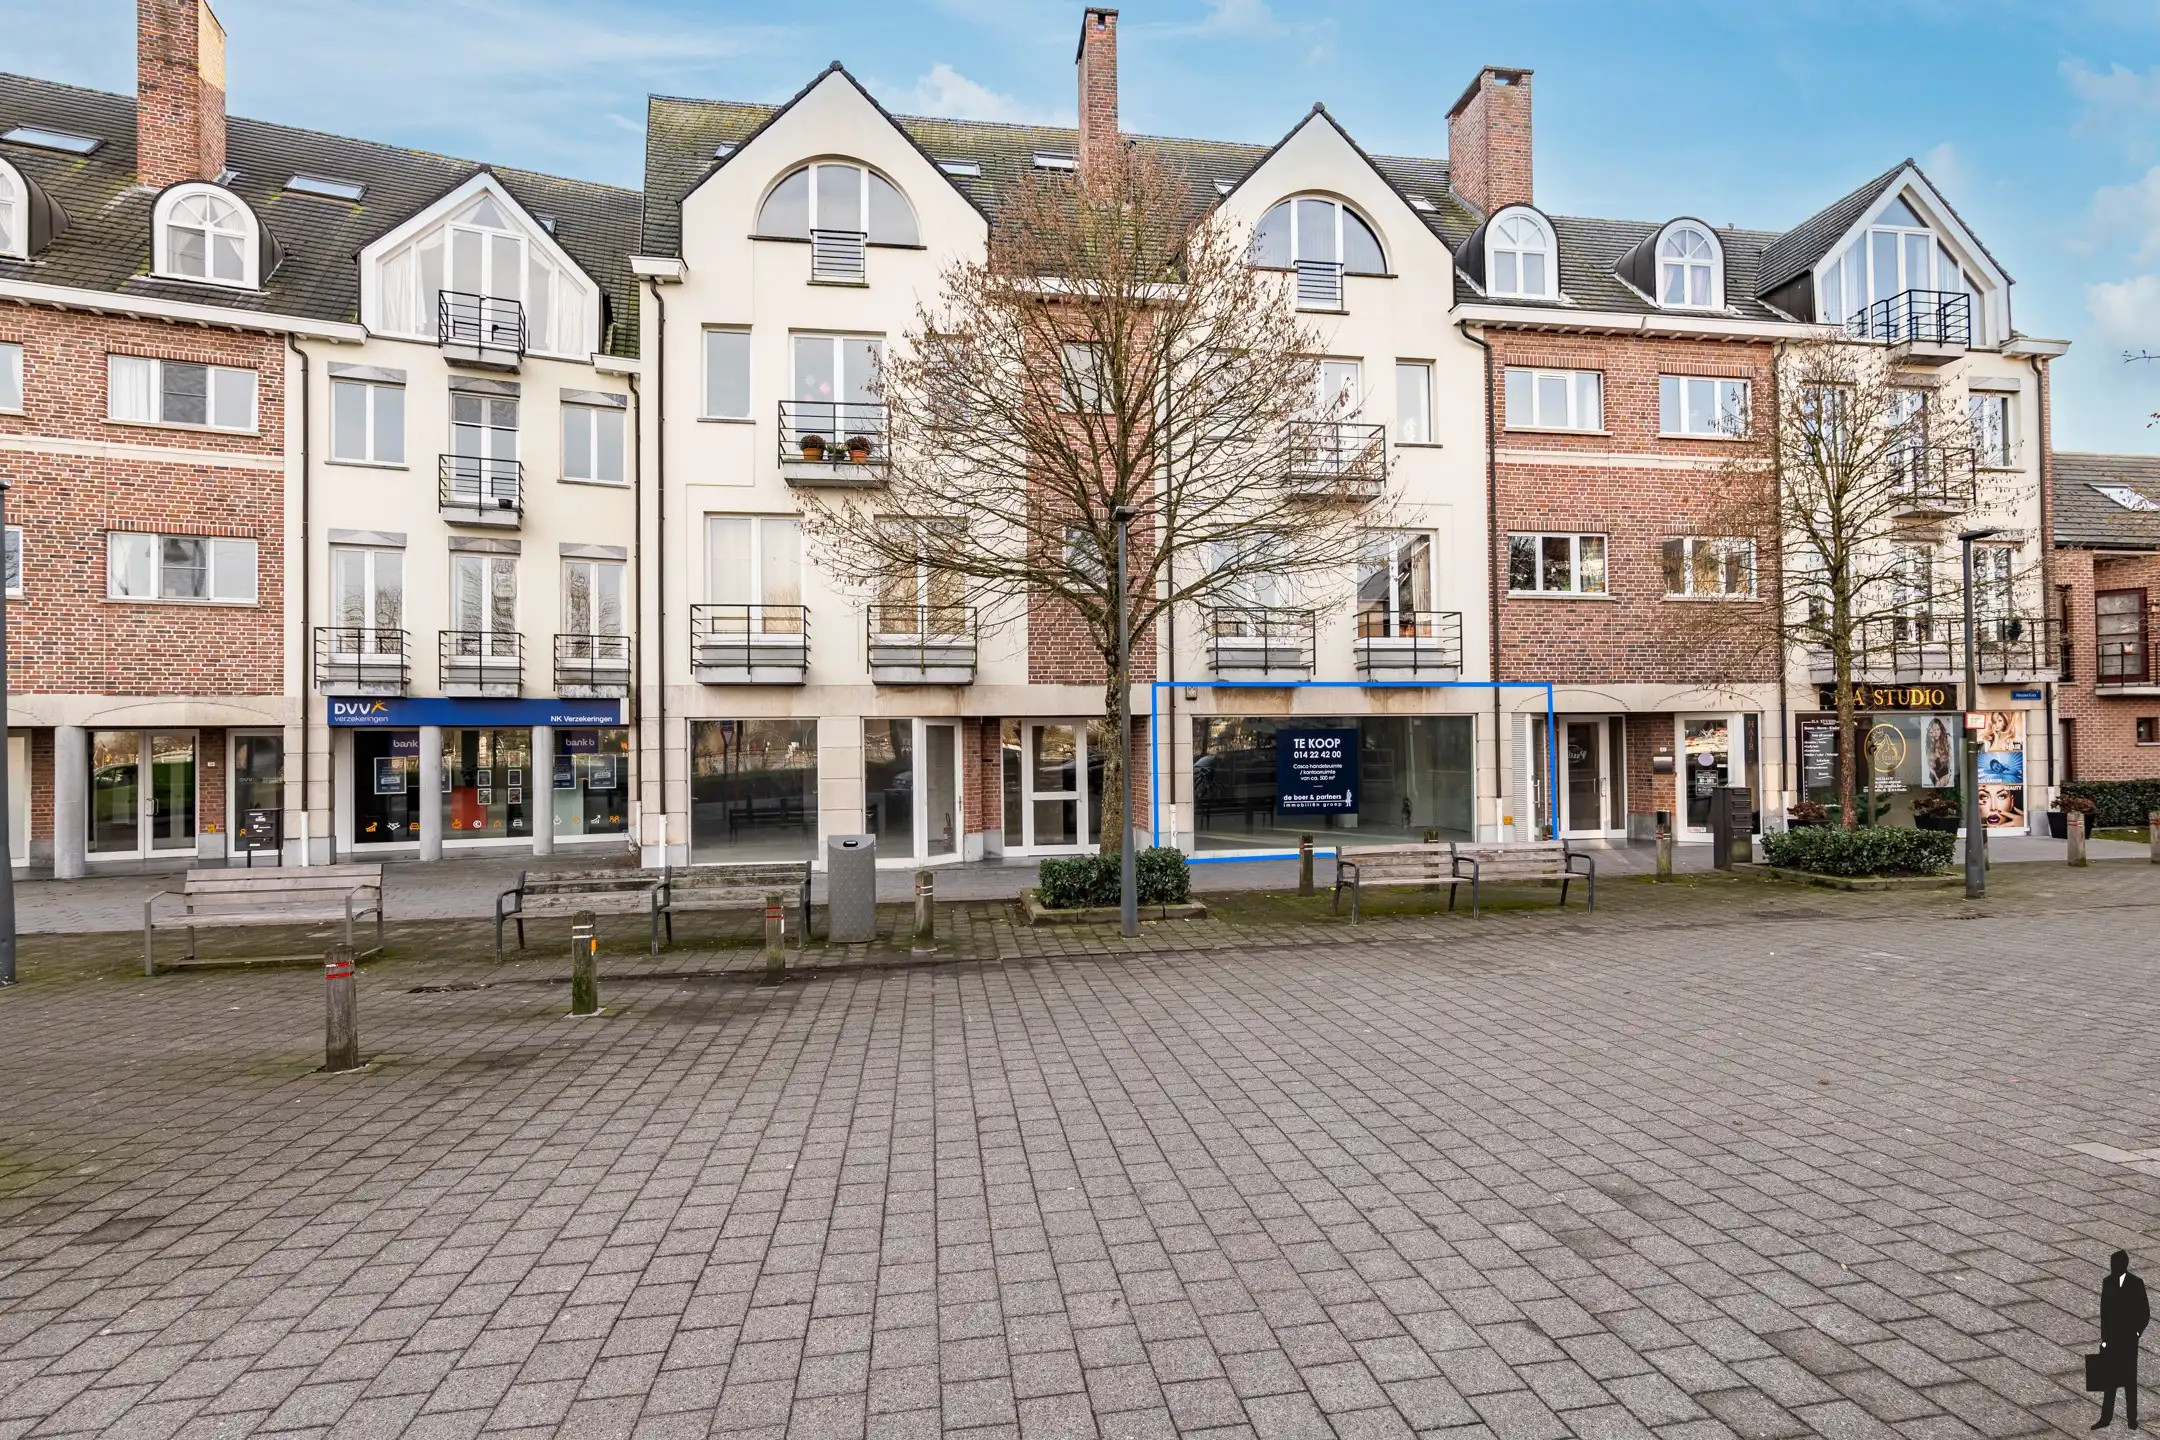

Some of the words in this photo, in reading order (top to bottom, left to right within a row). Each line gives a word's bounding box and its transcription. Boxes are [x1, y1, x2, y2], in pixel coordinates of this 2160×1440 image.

[1874, 689, 1945, 706] STUDIO
[334, 703, 371, 715] DVV
[334, 715, 389, 724] verzekeringen
[563, 715, 613, 724] Verzekeringen
[393, 739, 419, 748] bank
[565, 738, 587, 746] bank
[1294, 738, 1306, 749] TE
[1308, 738, 1341, 749] KOOP
[1294, 751, 1308, 759] 014
[1309, 751, 1319, 759] 22
[1315, 793, 1342, 802] partners
